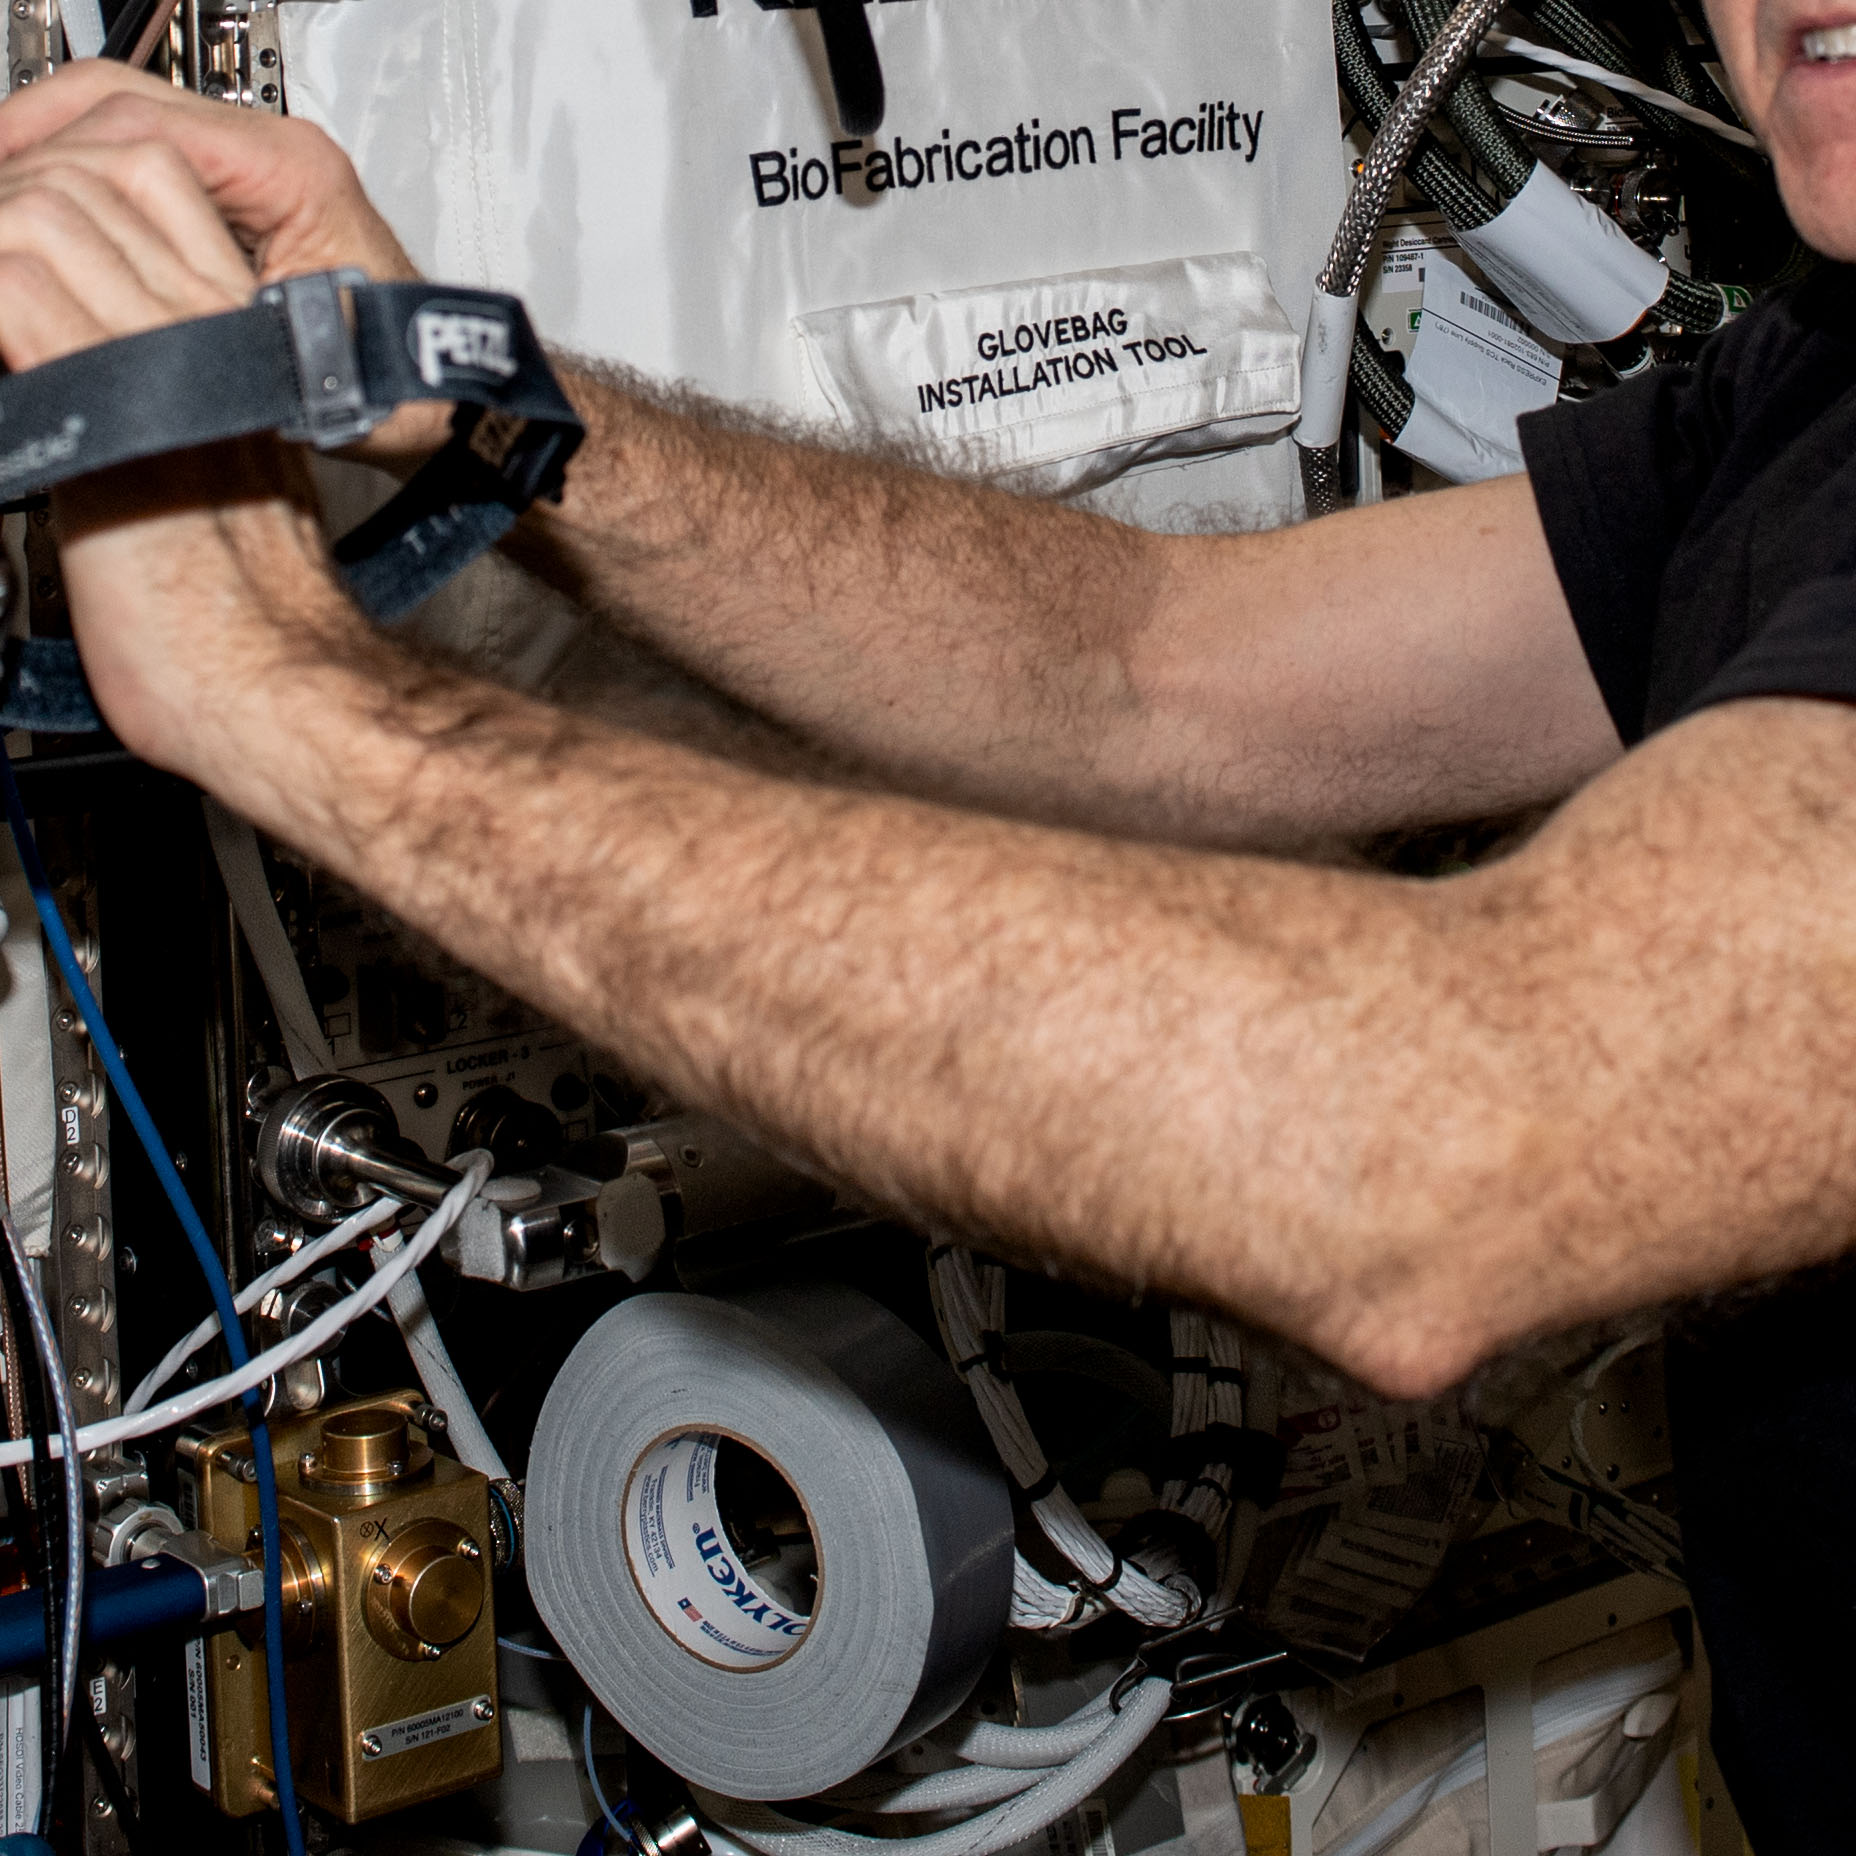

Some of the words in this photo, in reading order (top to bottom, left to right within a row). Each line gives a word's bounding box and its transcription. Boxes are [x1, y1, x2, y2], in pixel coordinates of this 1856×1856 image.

[750, 126, 1099, 209] BioFabrication
[1112, 102, 1266, 168] Facility
[977, 308, 1129, 361] GLOVEBAG
[917, 344, 1120, 413] INSTALLATION
[1123, 333, 1208, 373] TOOL
[1514, 364, 1548, 386] EXPRESS
[445, 1054, 509, 1075] LOCKER
[65, 1109, 77, 1124] D
[66, 1126, 77, 1142] 2
[93, 1680, 104, 1696] E
[94, 1696, 104, 1713] 2
[391, 1726, 406, 1740] P/N
[406, 1733, 420, 1746] S/N
[14, 1761, 24, 1791] Video
[14, 1793, 25, 1821] Cable
